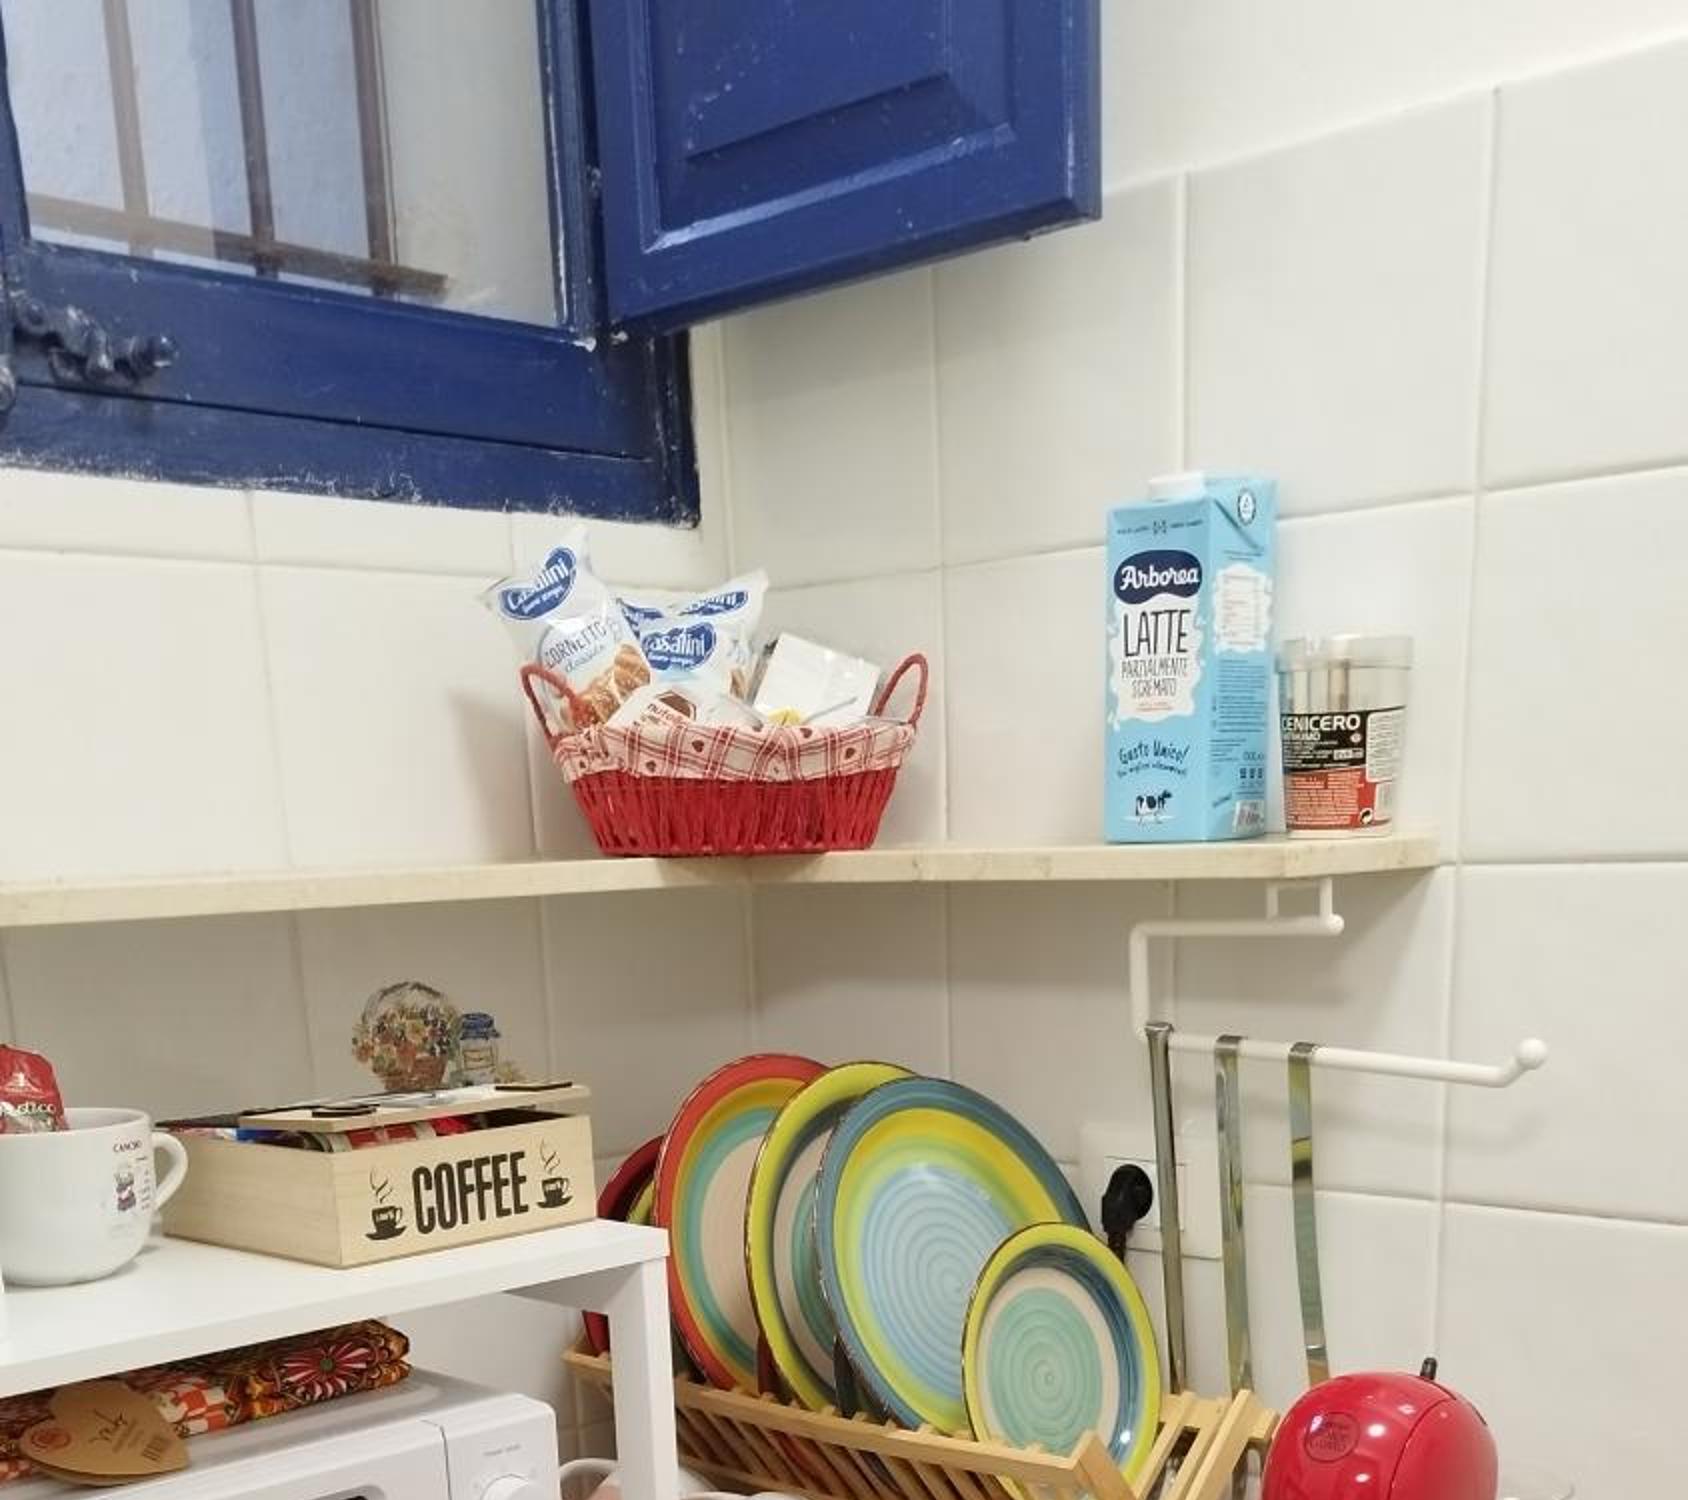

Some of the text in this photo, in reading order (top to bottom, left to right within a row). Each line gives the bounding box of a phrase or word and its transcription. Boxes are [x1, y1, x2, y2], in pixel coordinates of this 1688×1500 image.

[1119, 565, 1201, 591] Arborea
[1123, 609, 1191, 657] LATTE
[411, 1150, 530, 1235] COFFEE
